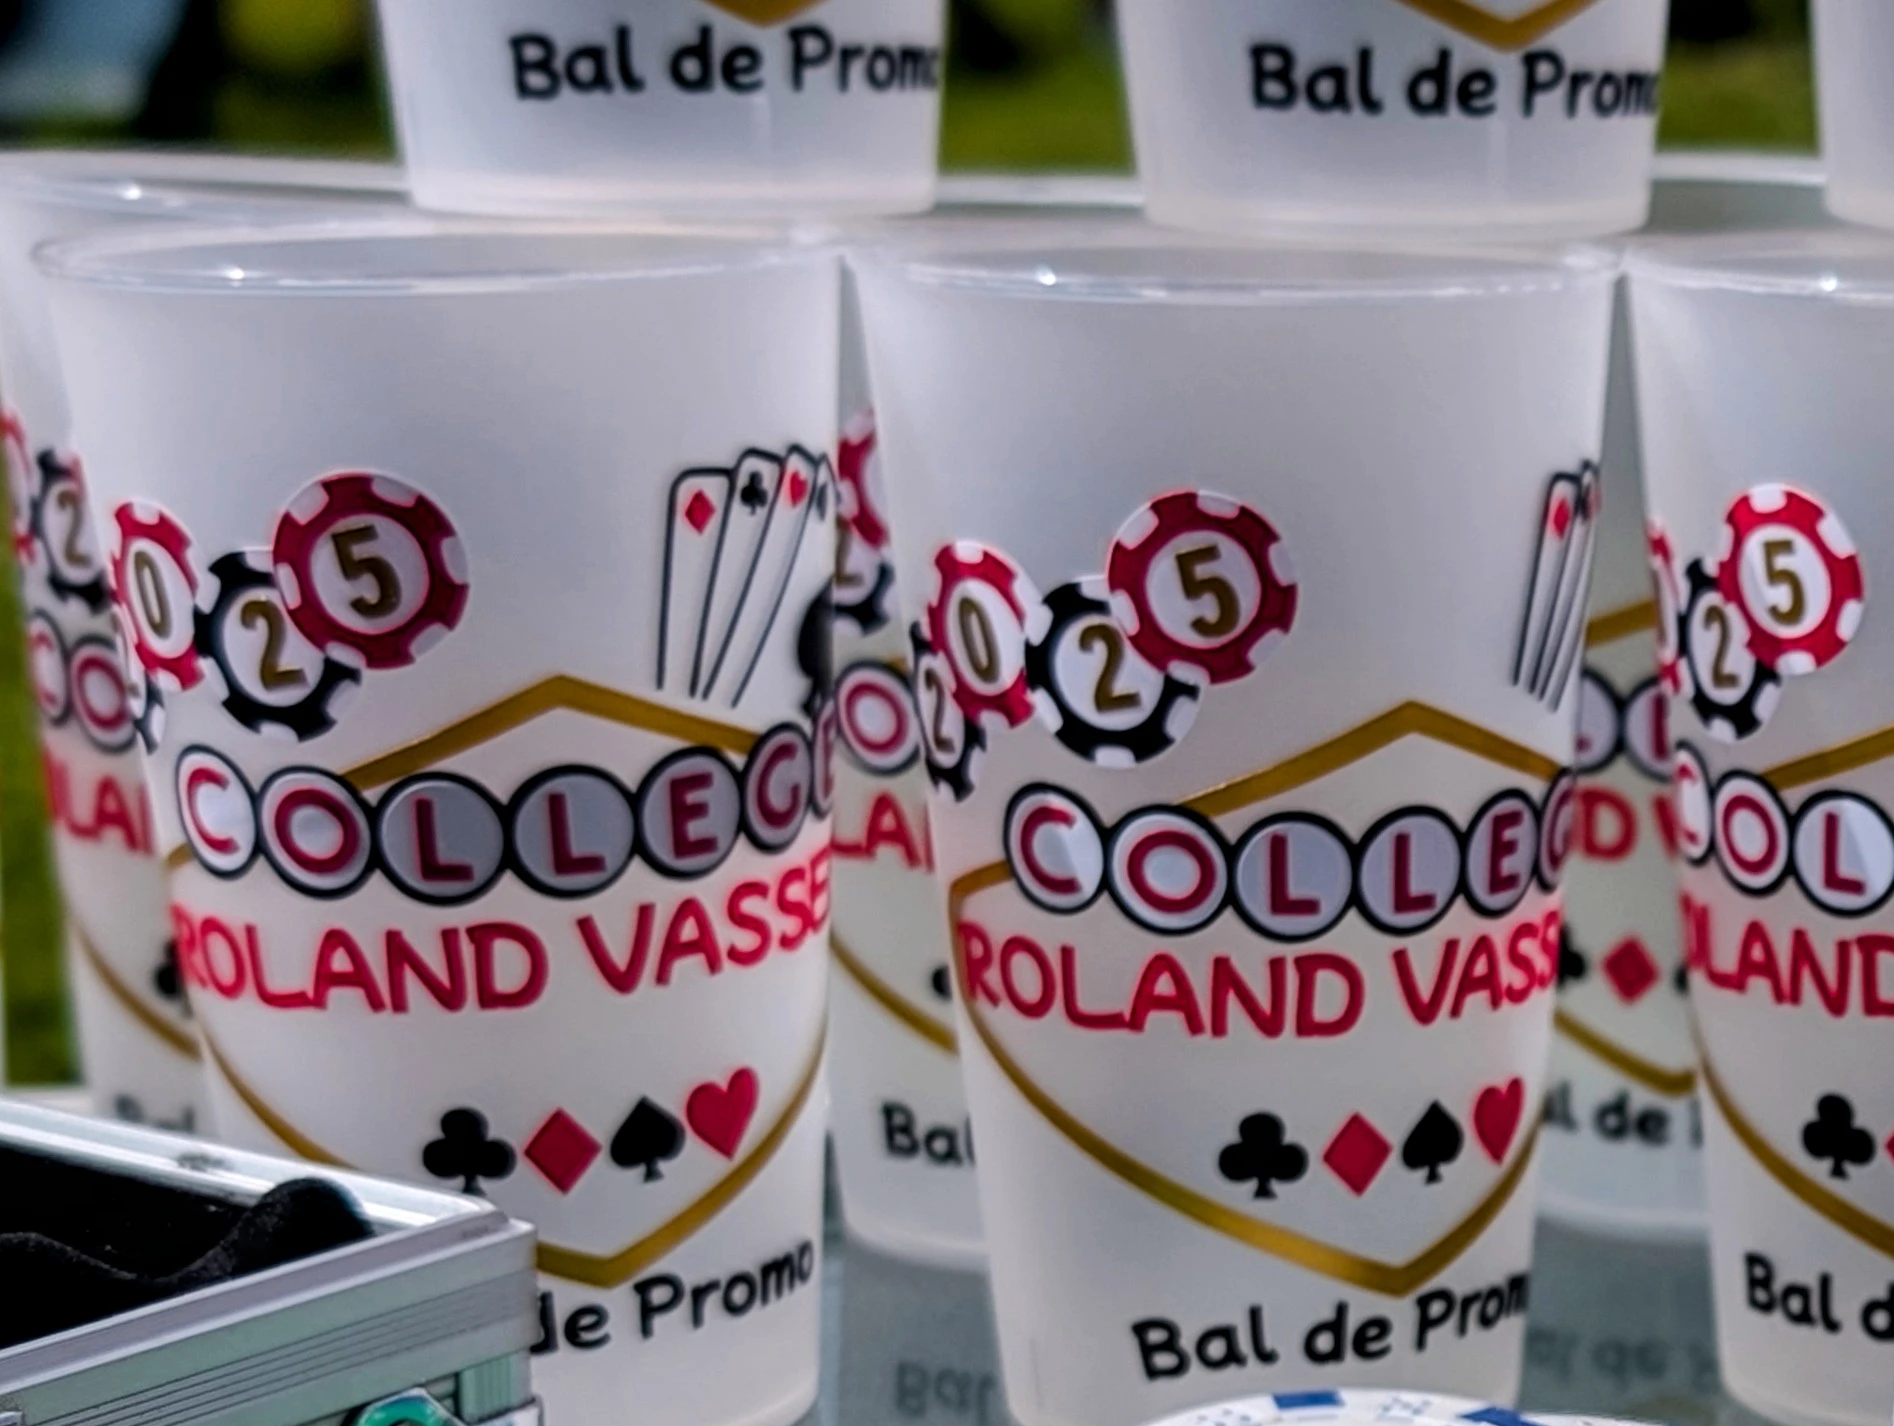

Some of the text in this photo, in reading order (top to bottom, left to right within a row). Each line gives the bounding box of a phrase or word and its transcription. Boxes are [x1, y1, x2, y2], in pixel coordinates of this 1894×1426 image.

[508, 23, 647, 100] Bal
[667, 23, 767, 94] de
[1249, 43, 1385, 116] Bal
[1406, 46, 1498, 118] de
[134, 550, 172, 639] 0
[239, 599, 309, 690] 2
[331, 524, 401, 618] 5
[957, 596, 1000, 685] 0
[1078, 622, 1142, 713] 2
[1174, 543, 1241, 639] 5
[1703, 539, 1806, 690] 2 5
[956, 920, 1367, 1040] ROLAND
[1593, 1087, 1670, 1148] de
[632, 1238, 815, 1341] Promo
[1745, 1250, 1844, 1336] Bal
[1130, 1303, 1281, 1383] Bal
[1302, 1300, 1395, 1365] de
